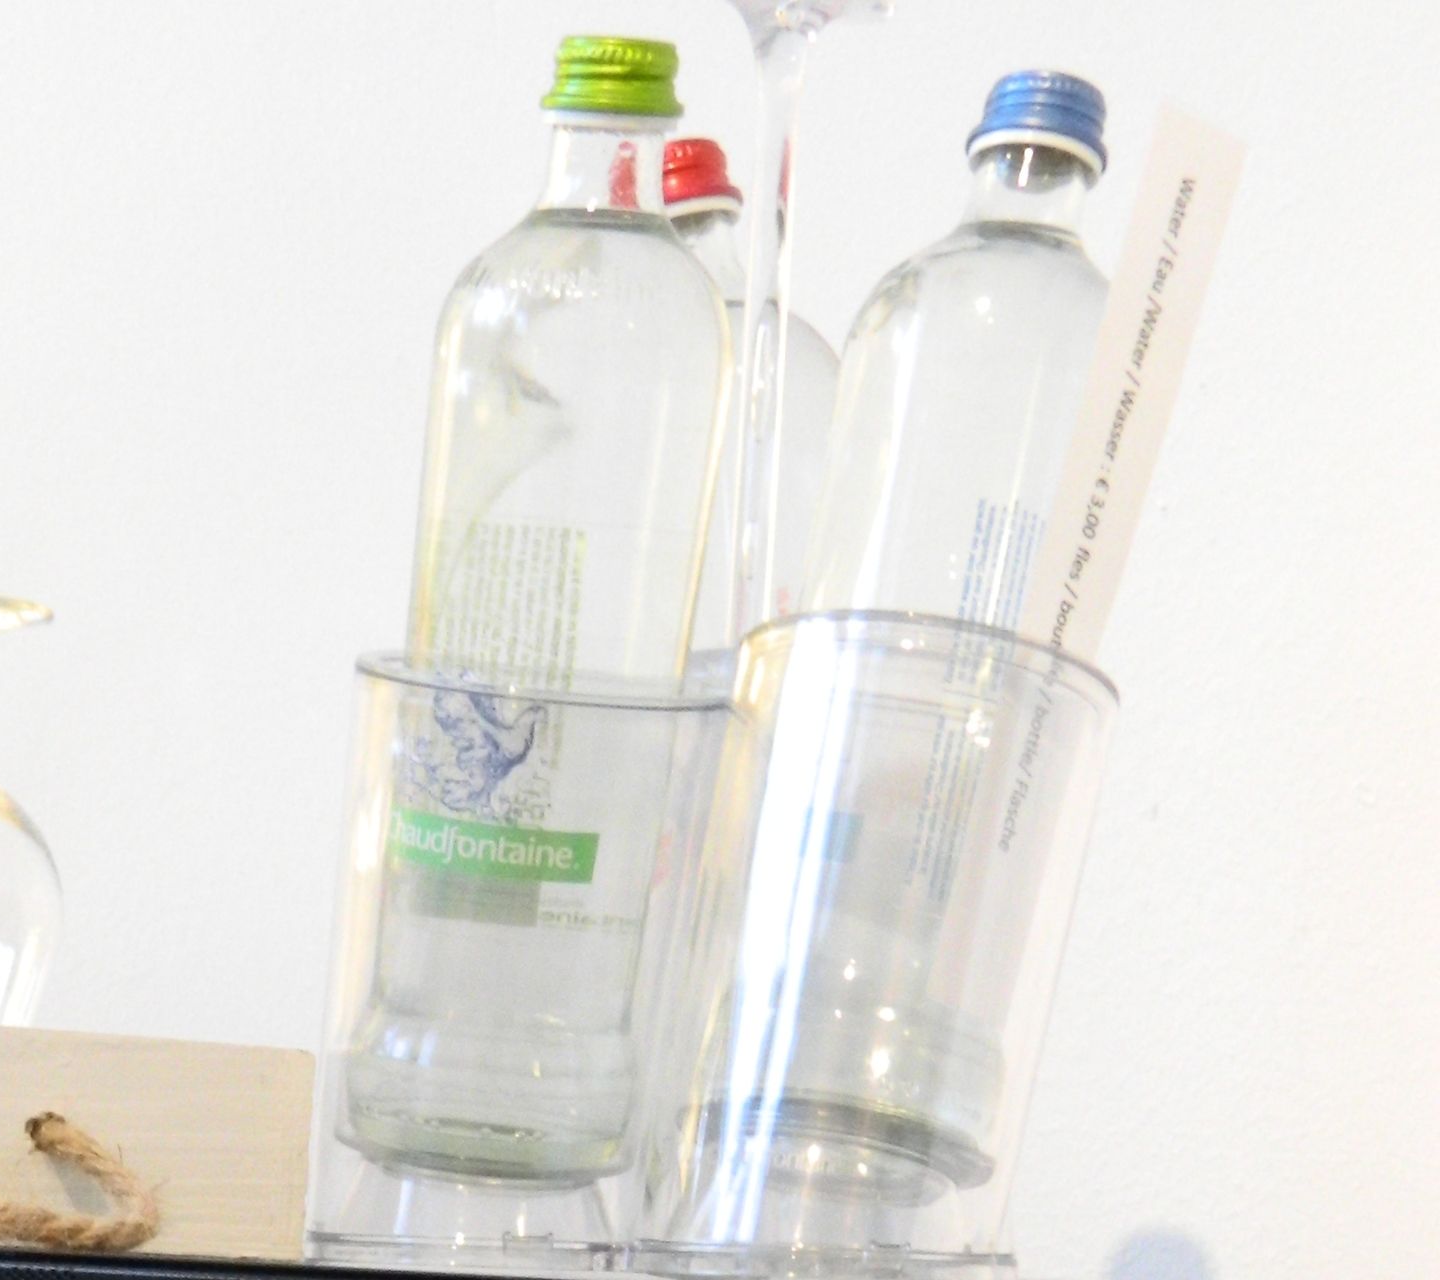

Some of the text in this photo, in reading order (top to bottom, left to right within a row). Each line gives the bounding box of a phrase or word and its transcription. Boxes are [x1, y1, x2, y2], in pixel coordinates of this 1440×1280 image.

[1167, 179, 1196, 238] Water
[1162, 239, 1177, 256] /
[1152, 256, 1174, 293] Eau
[1125, 370, 1140, 387] /
[1104, 390, 1136, 461] Wasser
[1095, 478, 1109, 493] €
[1081, 494, 1105, 540] 3,00
[1069, 547, 1090, 579] fles
[1064, 582, 1078, 599] /
[998, 778, 1030, 852] Flasche
